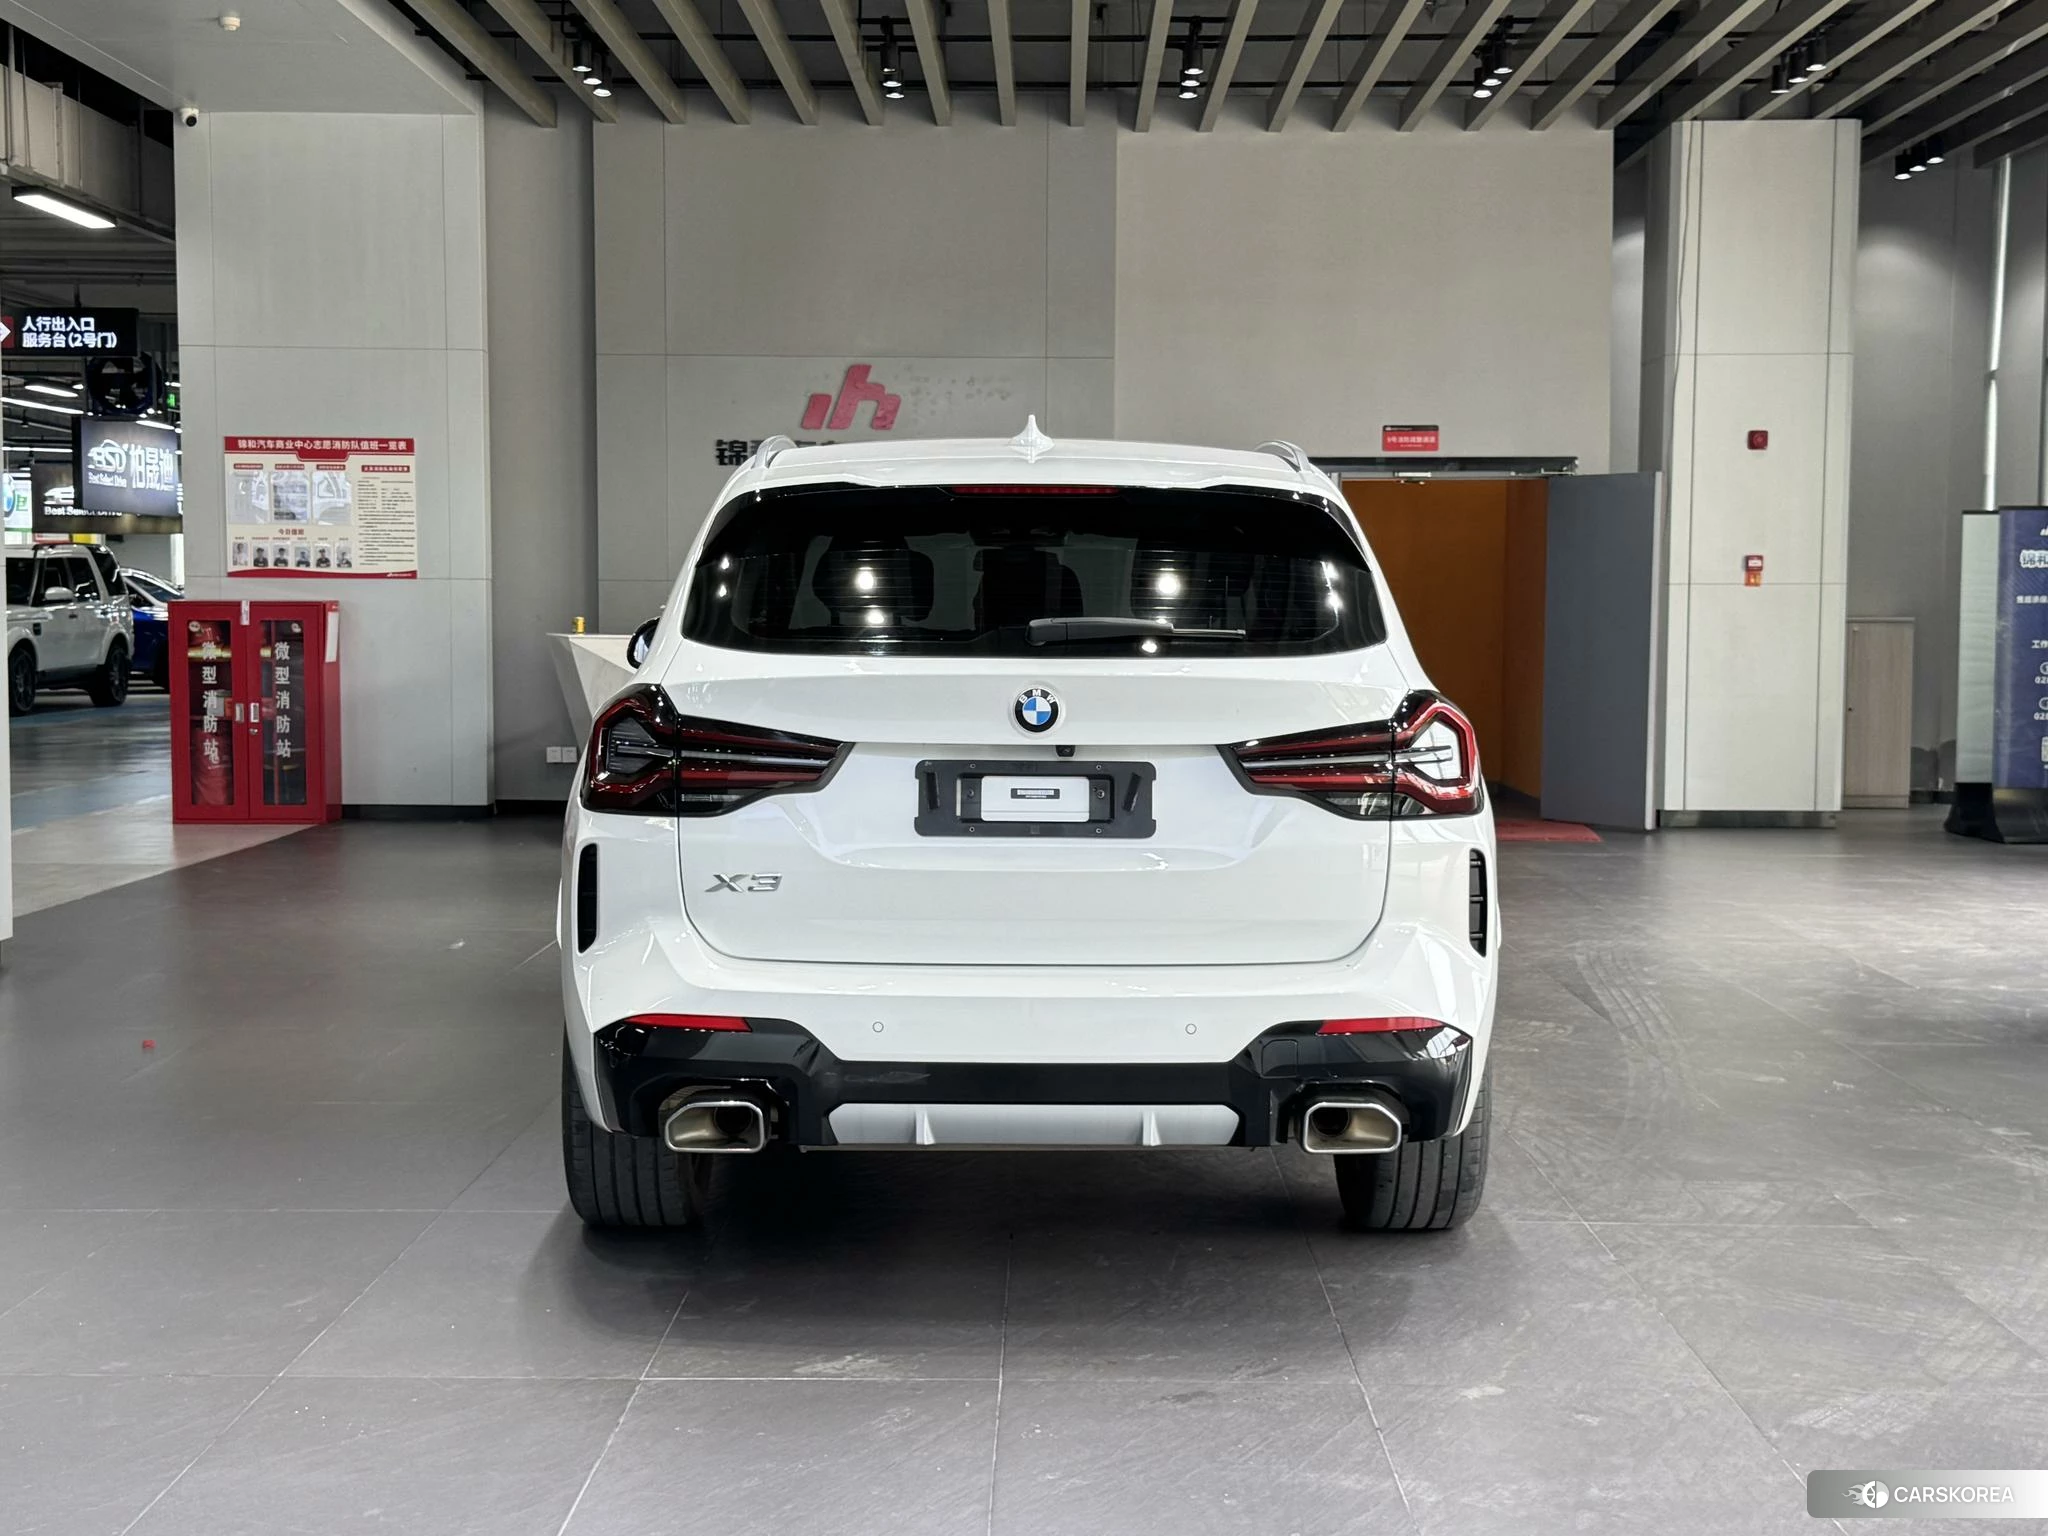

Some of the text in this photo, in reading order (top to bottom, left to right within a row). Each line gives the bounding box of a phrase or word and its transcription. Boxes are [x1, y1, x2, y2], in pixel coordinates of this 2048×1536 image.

[22, 316, 95, 331] 人行出入口
[22, 332, 117, 348] 服务台(2号门)
[44, 506, 65, 516] Best
[202, 641, 218, 759] 微型消防站
[274, 641, 291, 758] 微型消防站
[1018, 689, 1057, 704] BMW
[704, 873, 783, 892] X3
